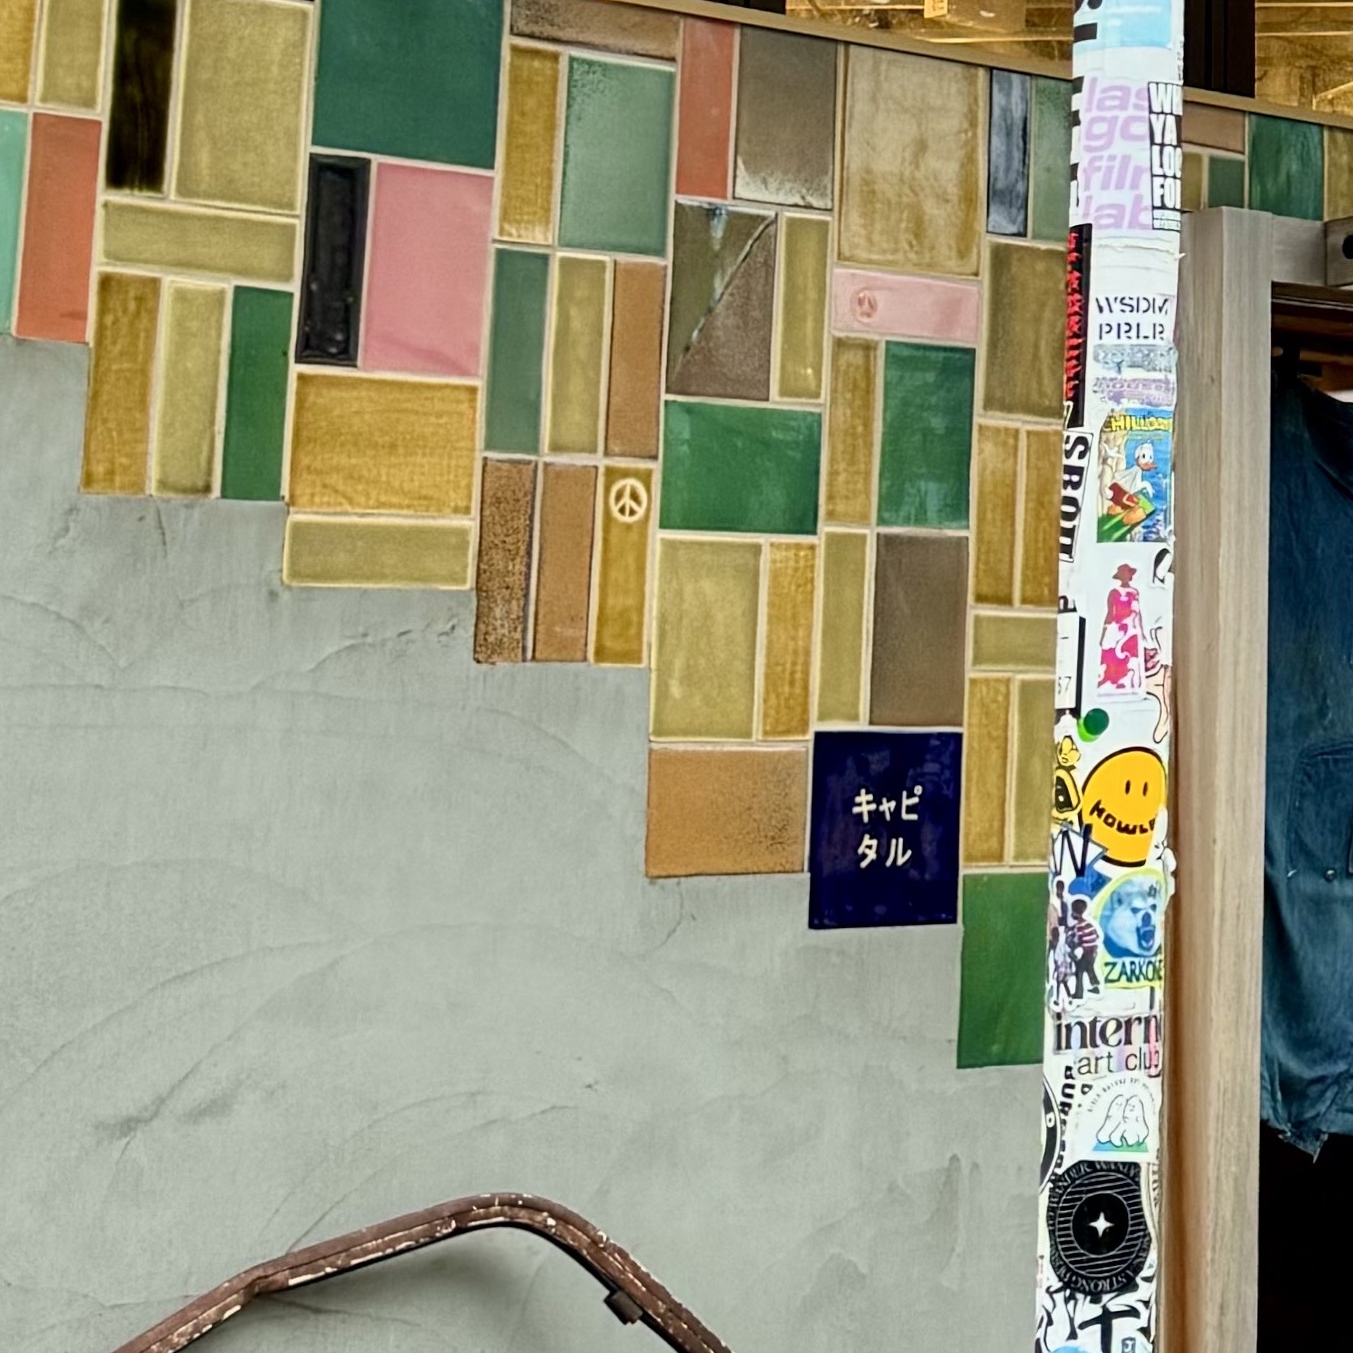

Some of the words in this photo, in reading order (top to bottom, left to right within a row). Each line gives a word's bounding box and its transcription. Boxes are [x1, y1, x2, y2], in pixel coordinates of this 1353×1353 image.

[852, 785, 923, 824] キャピ
[857, 834, 913, 869] タル
[1077, 1051, 1114, 1075] art
